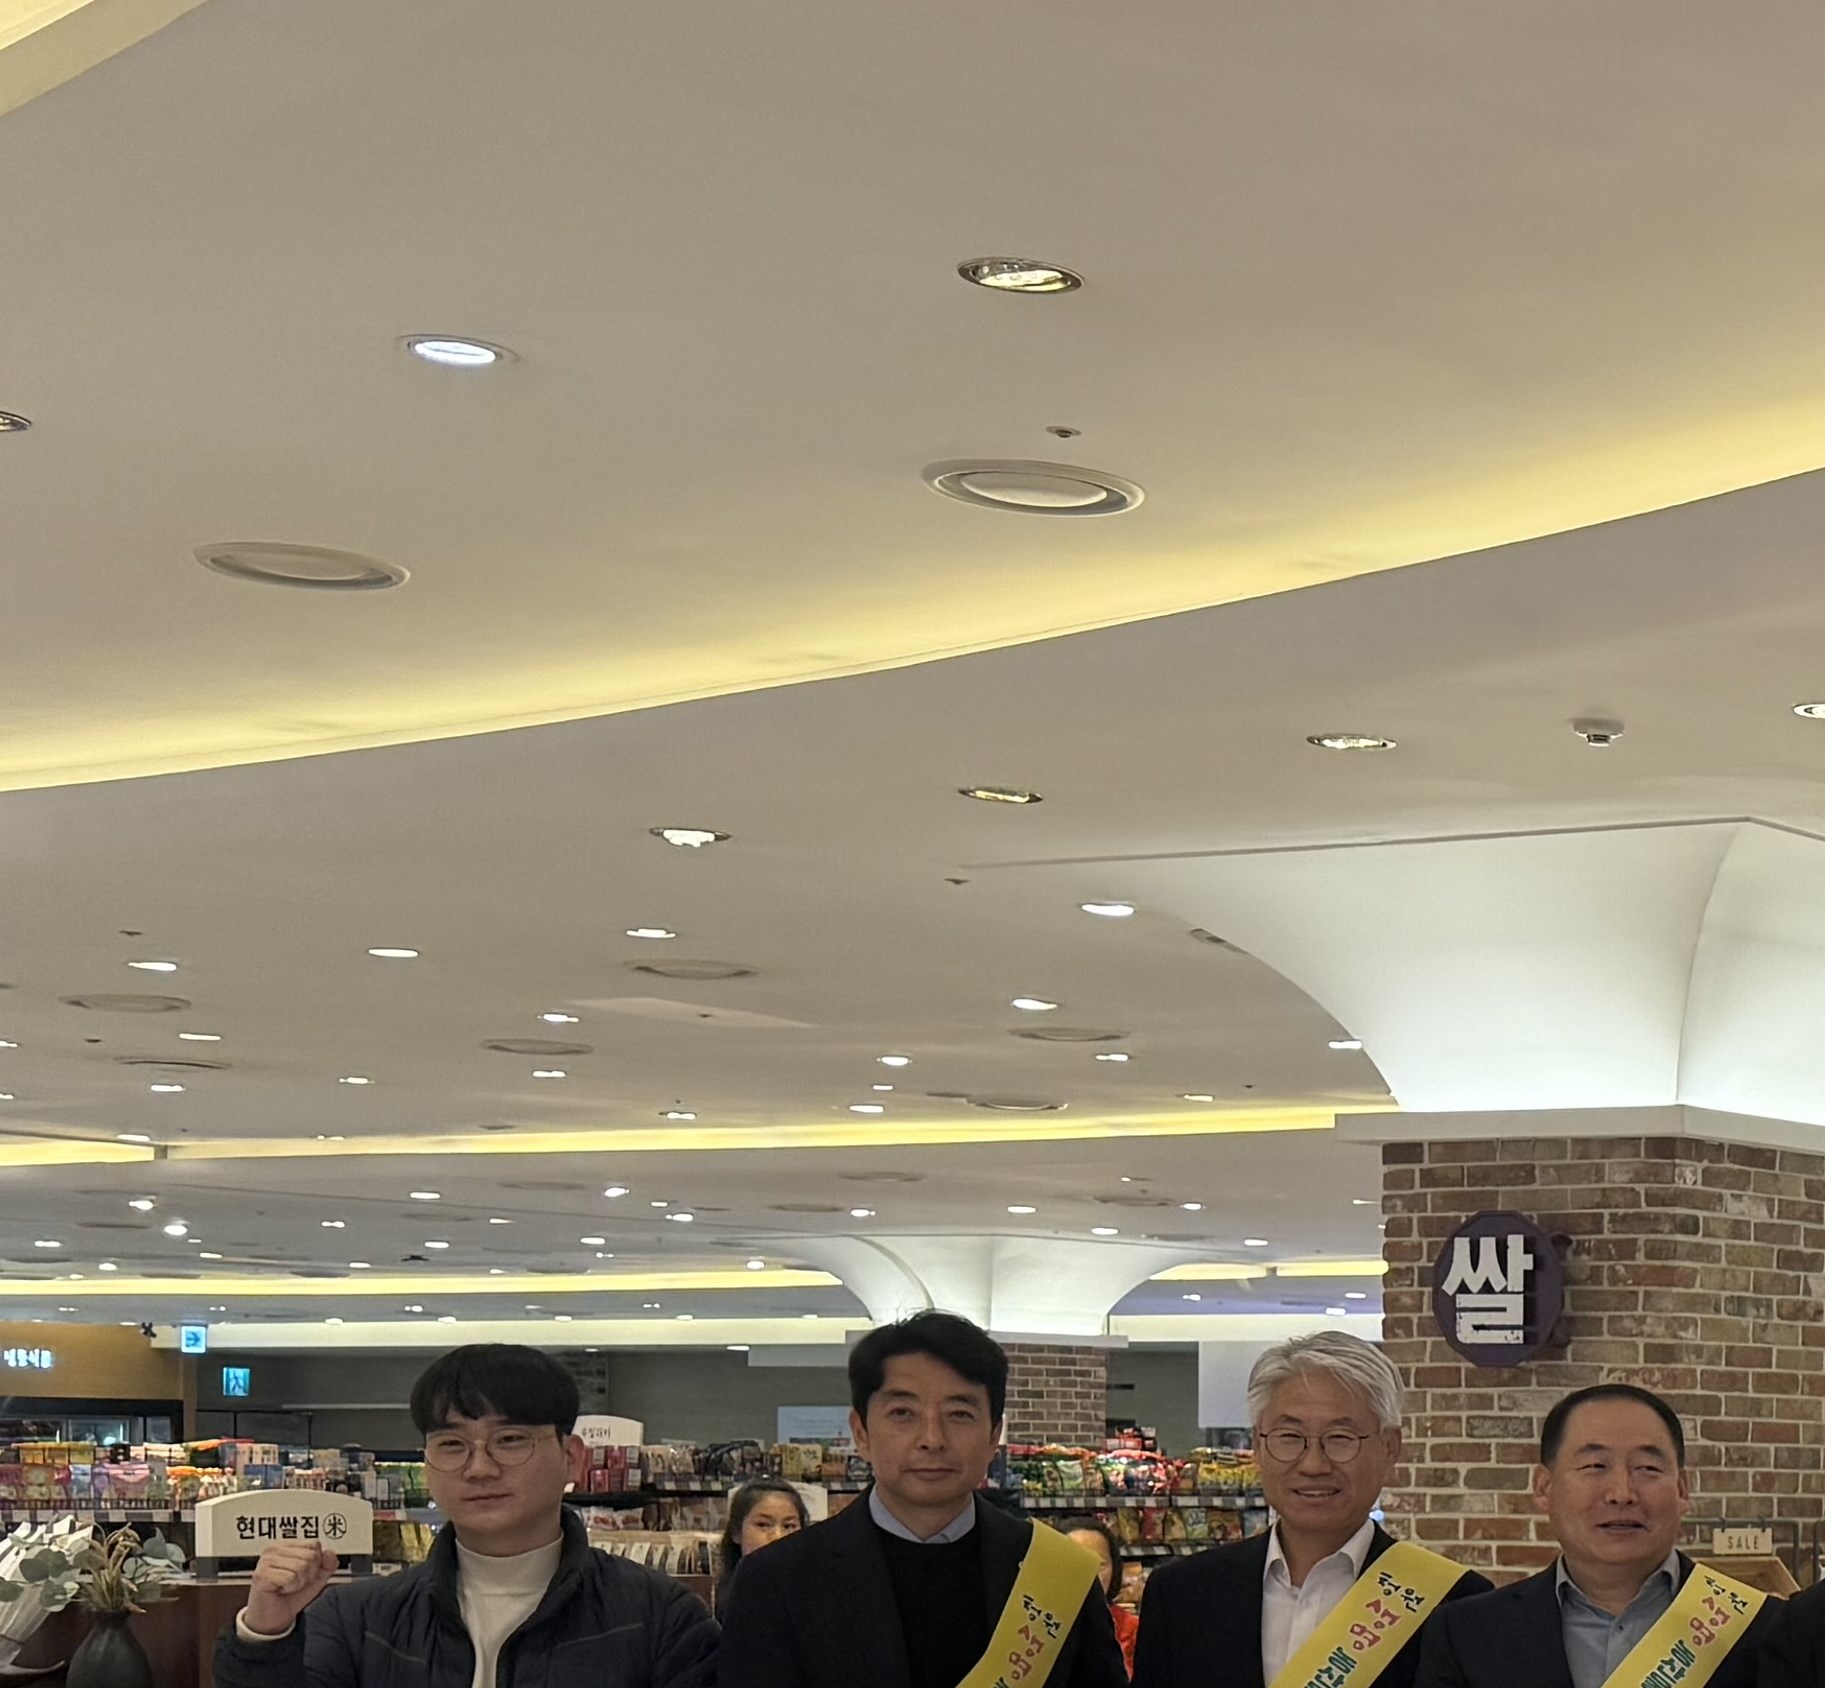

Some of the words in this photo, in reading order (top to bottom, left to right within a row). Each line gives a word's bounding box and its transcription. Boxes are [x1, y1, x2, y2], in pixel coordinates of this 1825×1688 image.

[1442, 1233, 1534, 1345] 쌀
[236, 1514, 320, 1540] 현대쌀집
[1727, 1535, 1760, 1550] SALE
[1378, 1571, 1426, 1613] 청원
[1022, 1594, 1062, 1639] 청원
[1350, 1598, 1403, 1651] 생명
[1690, 1596, 1732, 1647] 생명
[1009, 1624, 1046, 1681] 생명
